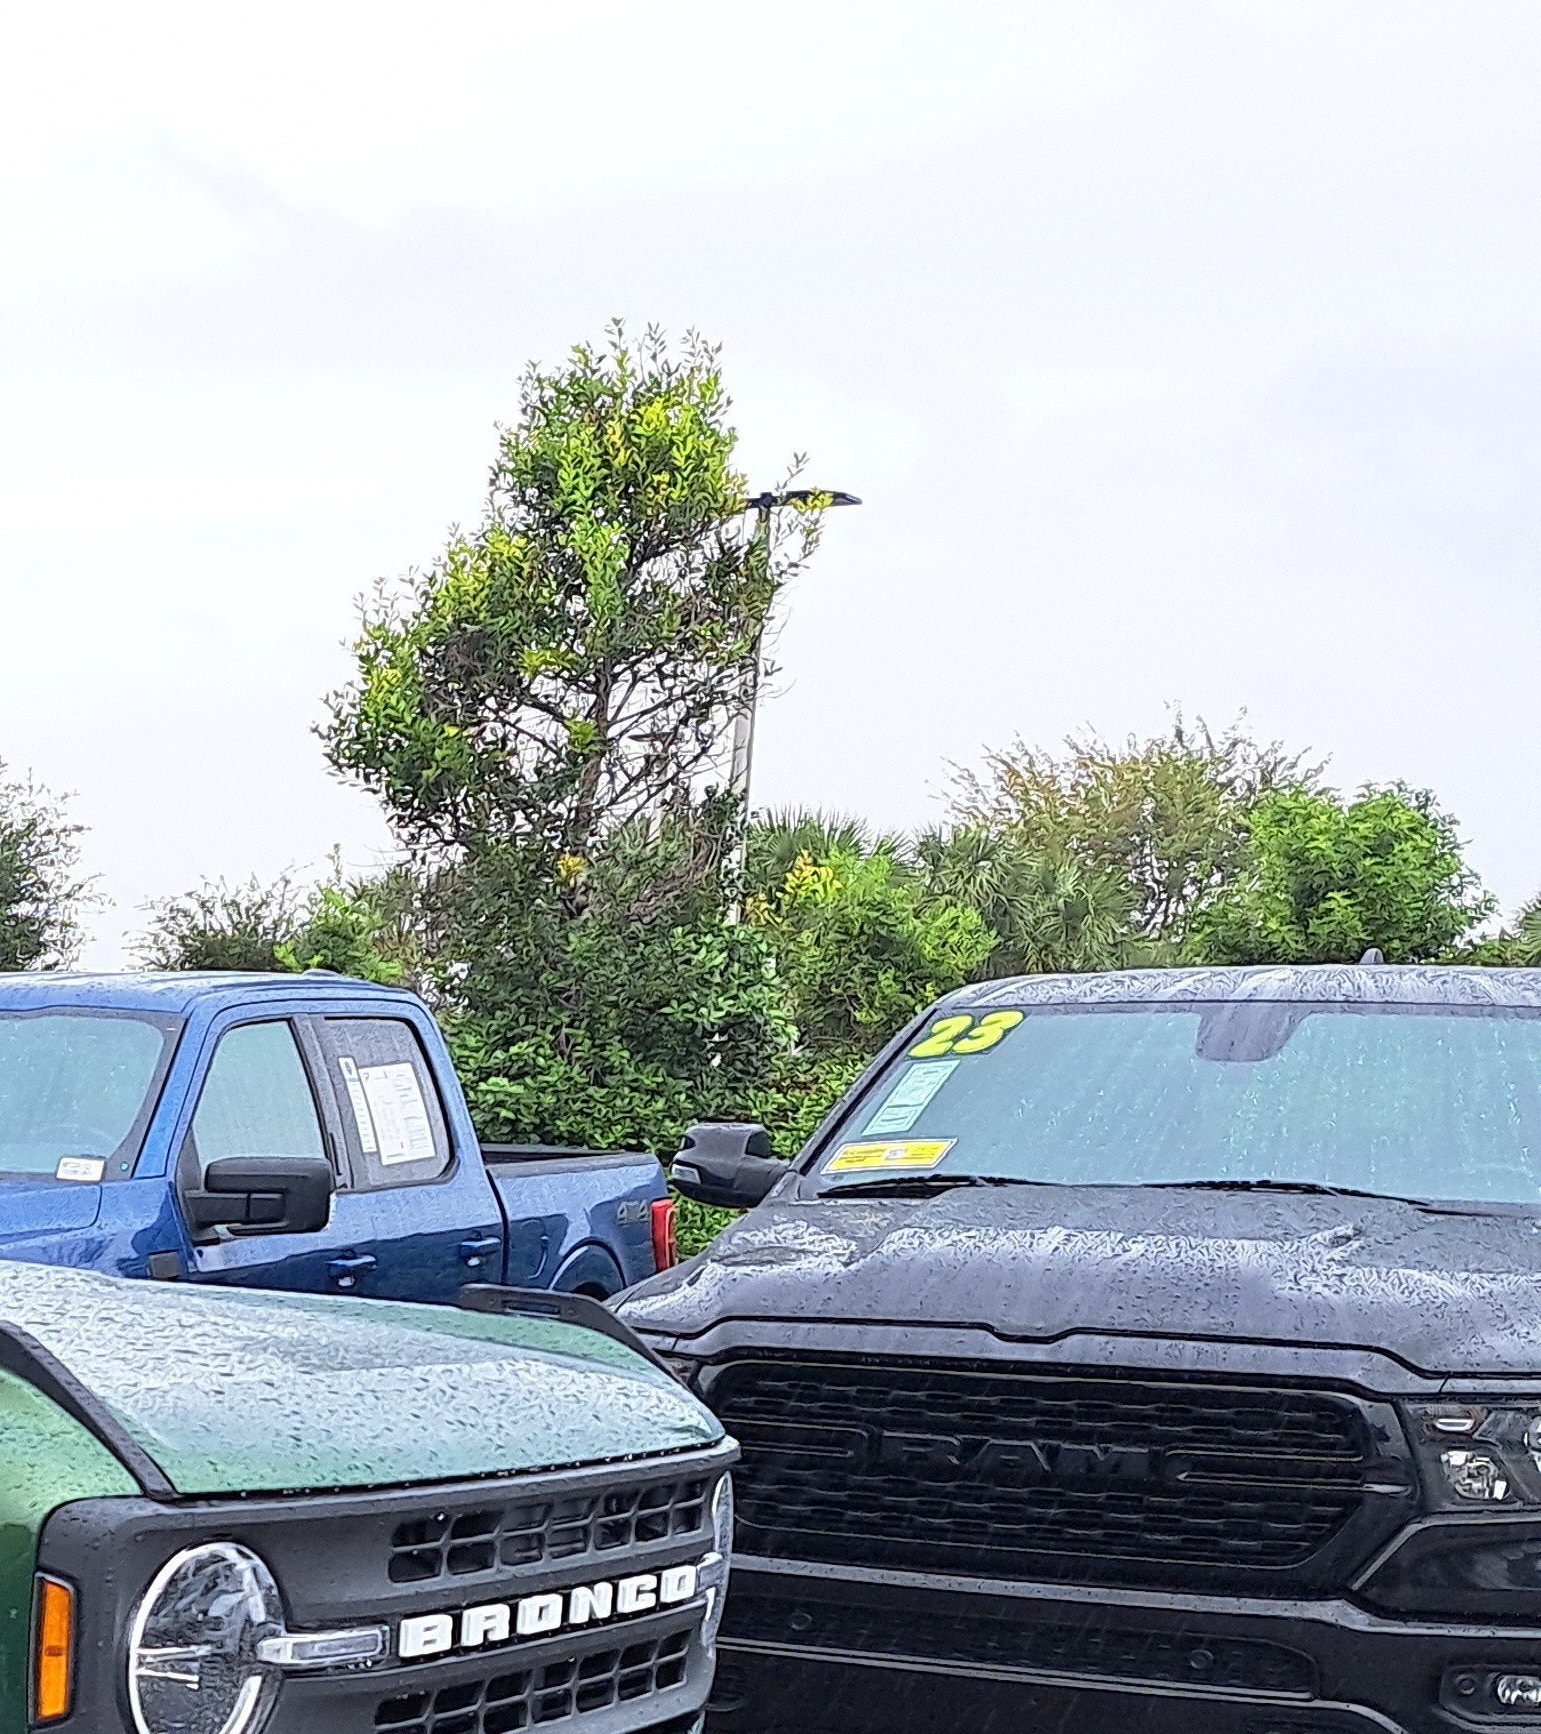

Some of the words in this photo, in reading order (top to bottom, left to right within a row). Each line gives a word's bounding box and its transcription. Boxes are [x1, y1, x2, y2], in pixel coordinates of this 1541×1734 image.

[907, 1010, 1025, 1058] 23
[880, 1430, 1151, 1486] RAM
[399, 1565, 697, 1657] BRONCO
